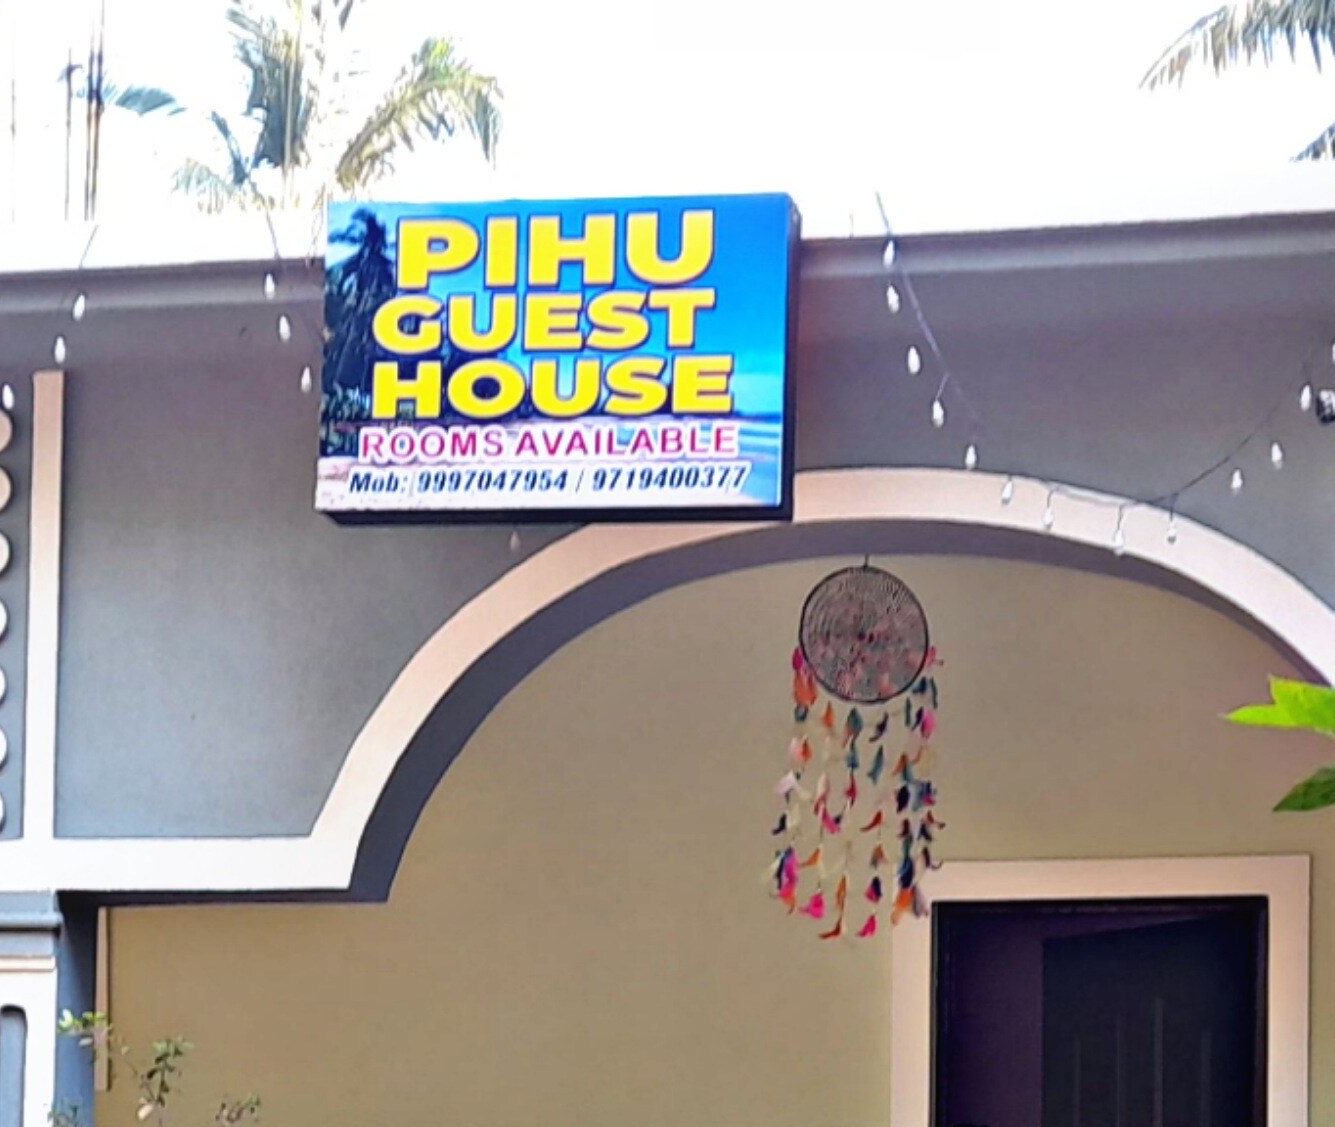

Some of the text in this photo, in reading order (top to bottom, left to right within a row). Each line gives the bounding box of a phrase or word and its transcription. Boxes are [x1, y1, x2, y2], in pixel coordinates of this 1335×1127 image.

[397, 209, 715, 289] PIHU
[372, 288, 717, 355] GUEST
[371, 355, 735, 418] HOUSE
[362, 426, 736, 458] ROOMS AVAILABLE
[349, 471, 408, 494] Mob:
[416, 469, 569, 493] 9997047954
[592, 465, 747, 492] 9719400377
